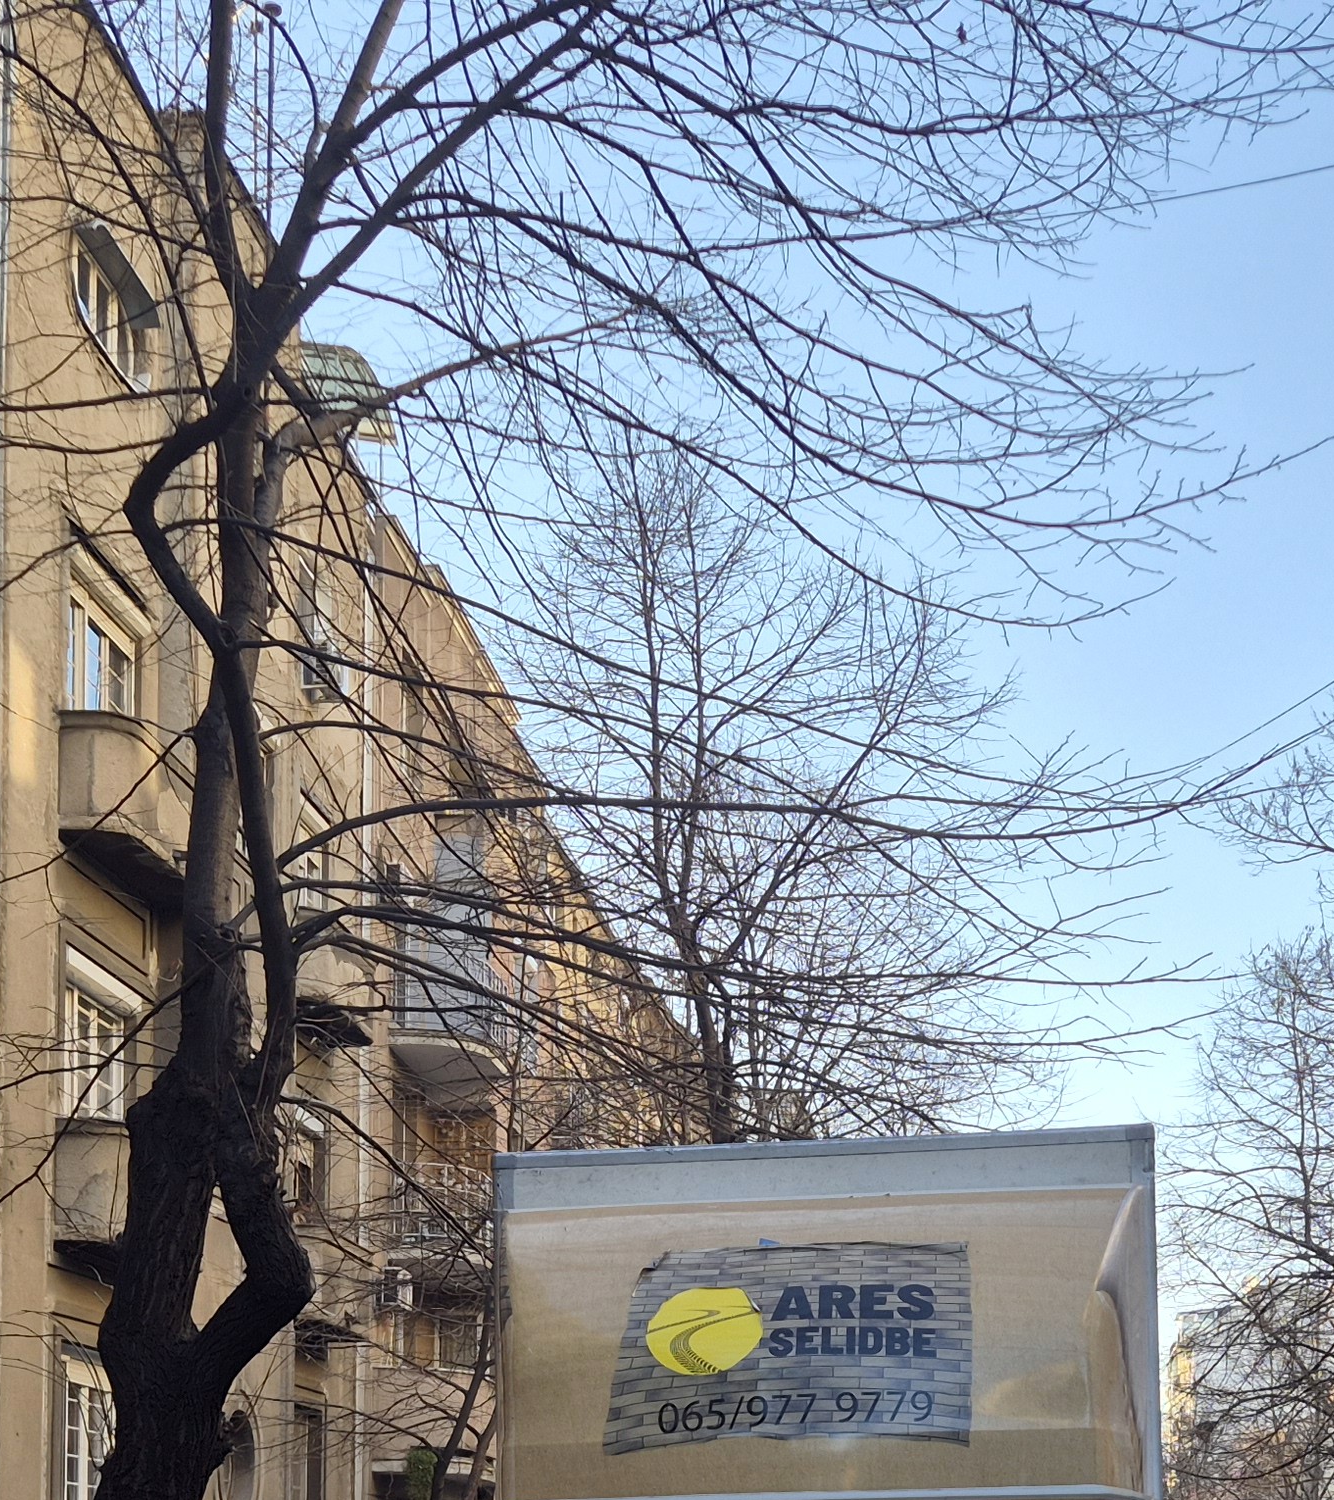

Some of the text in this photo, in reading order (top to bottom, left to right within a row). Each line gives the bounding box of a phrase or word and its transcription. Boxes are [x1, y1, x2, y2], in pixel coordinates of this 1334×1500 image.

[770, 1284, 935, 1321] ARES
[768, 1326, 937, 1357] SELIDBE
[657, 1390, 934, 1434] 065/977 9779
